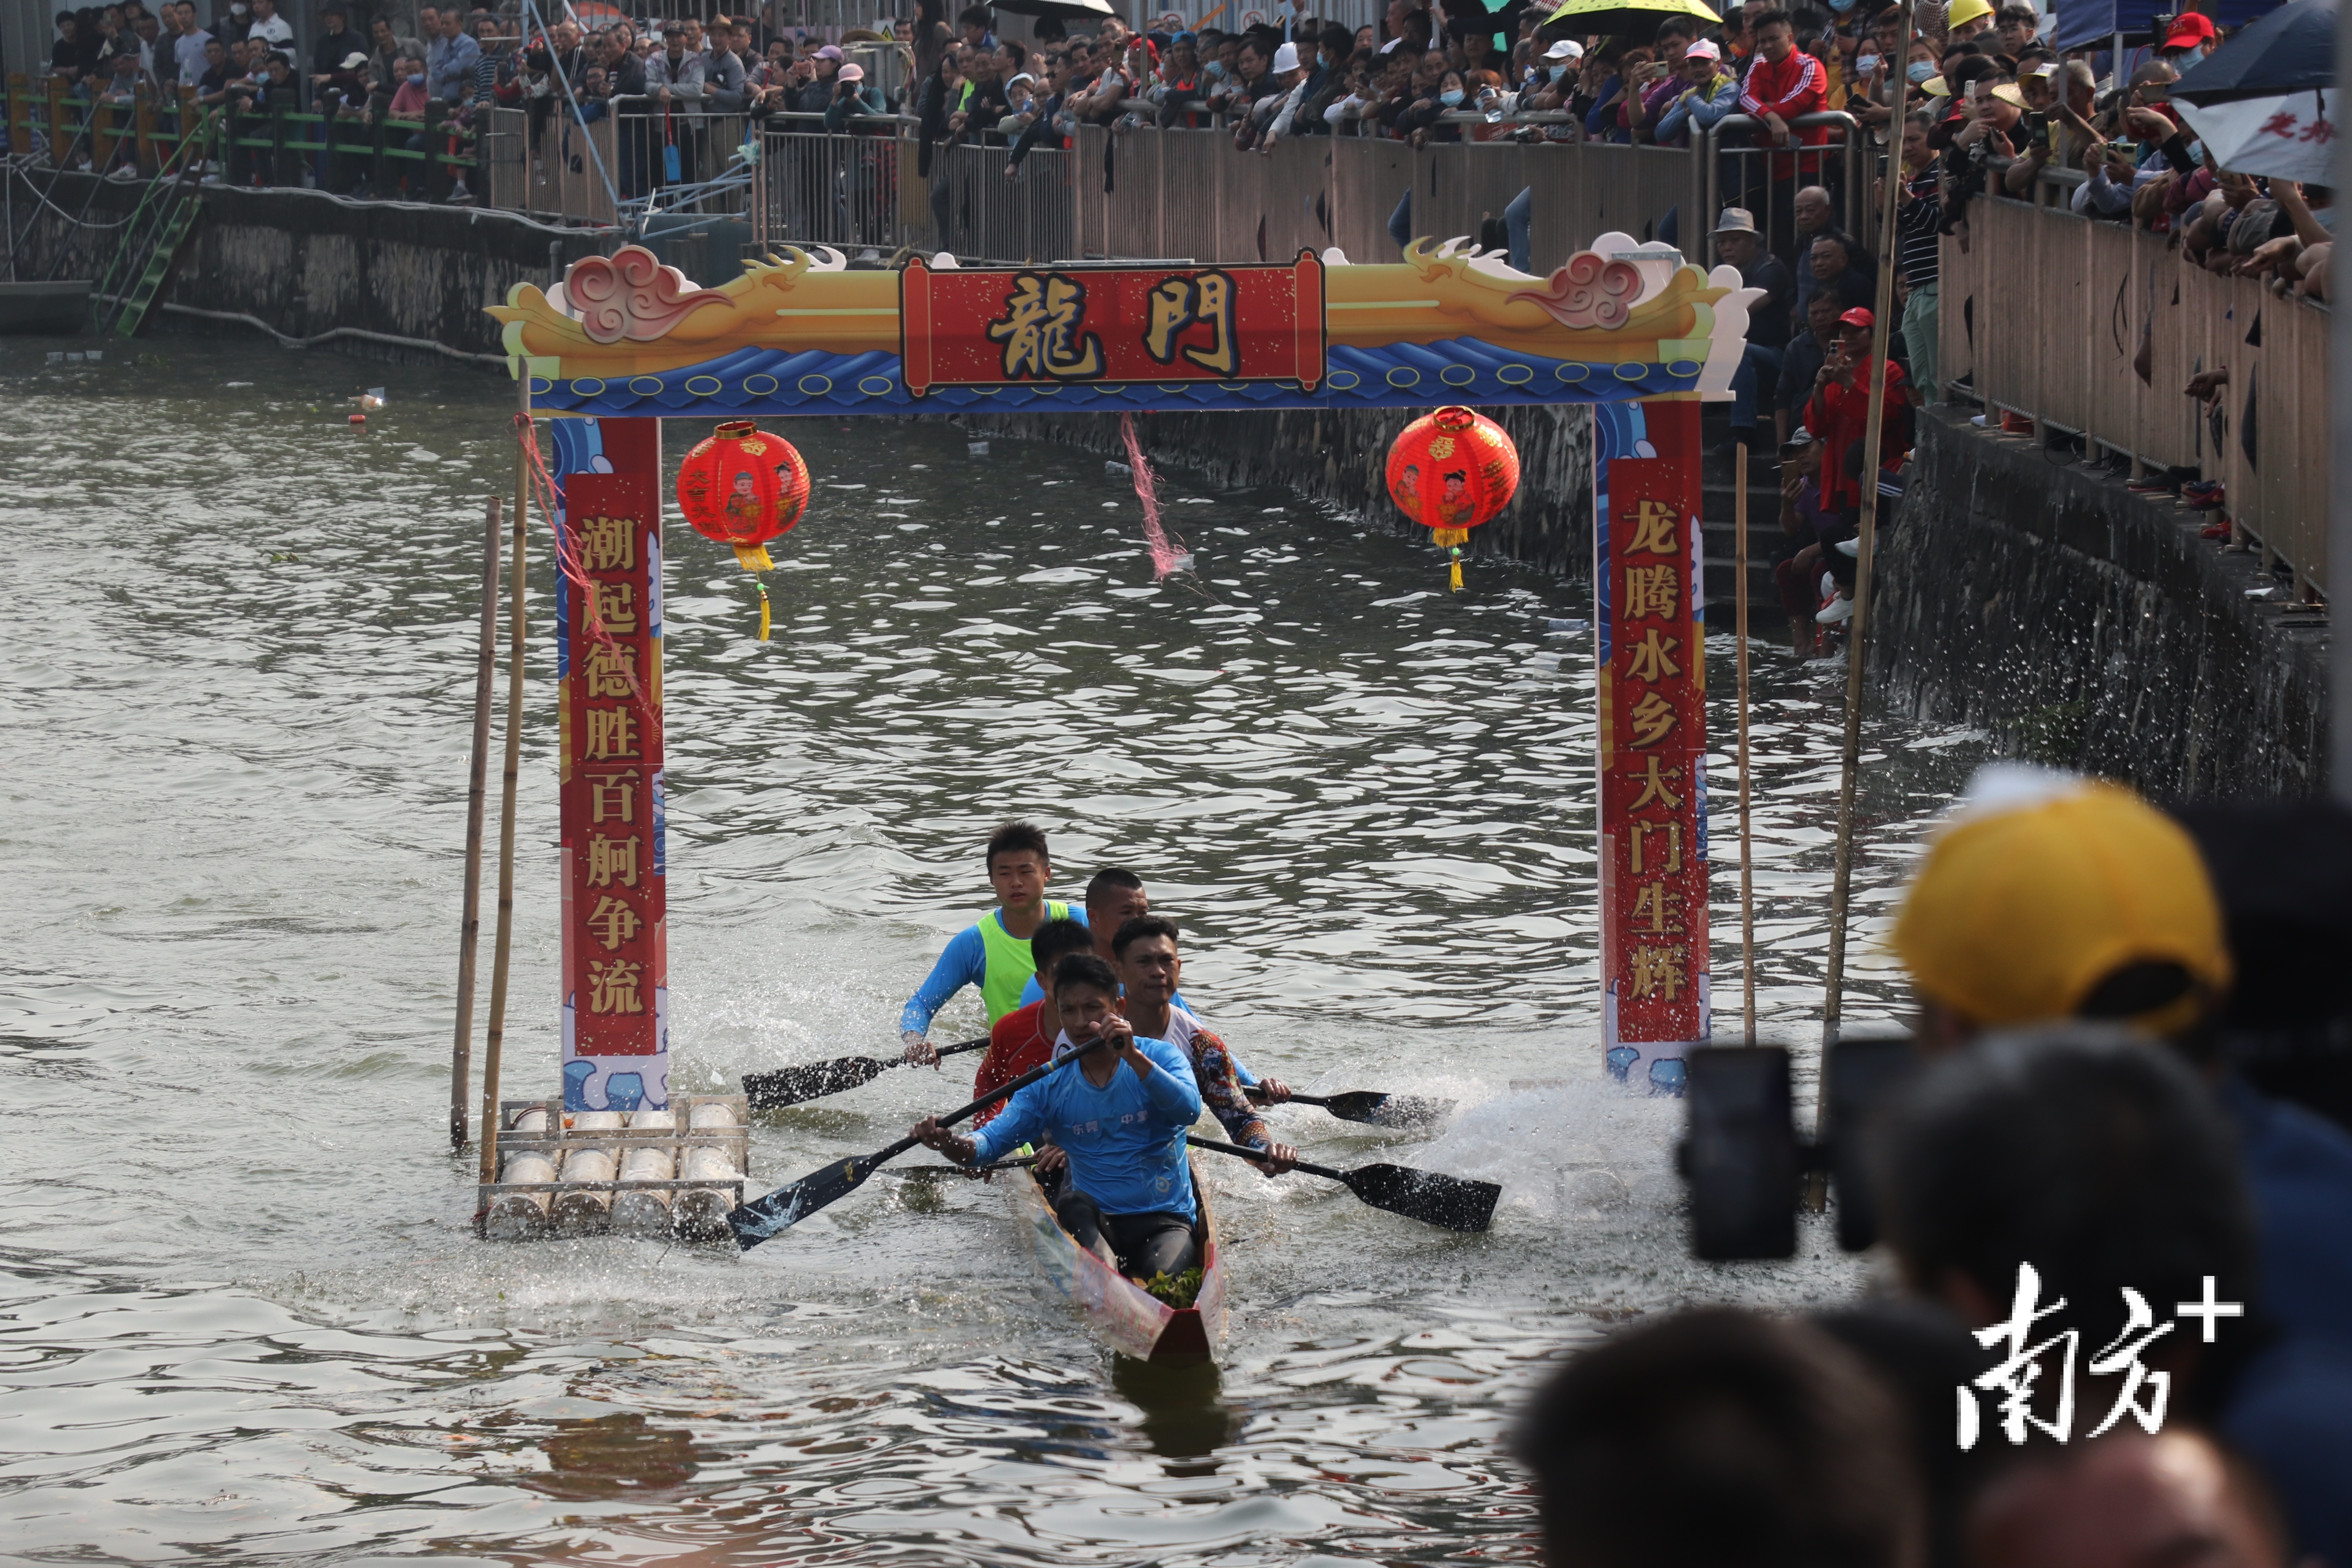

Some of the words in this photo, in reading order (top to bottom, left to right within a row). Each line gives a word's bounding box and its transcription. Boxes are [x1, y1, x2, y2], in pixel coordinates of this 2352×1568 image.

[988, 271, 1235, 378] 龍門
[579, 516, 644, 1014] 潮起德胜百舸争流
[1622, 499, 1689, 1001] 龙腾水乡大门生辉
[1072, 1120, 1099, 1135] 东莞
